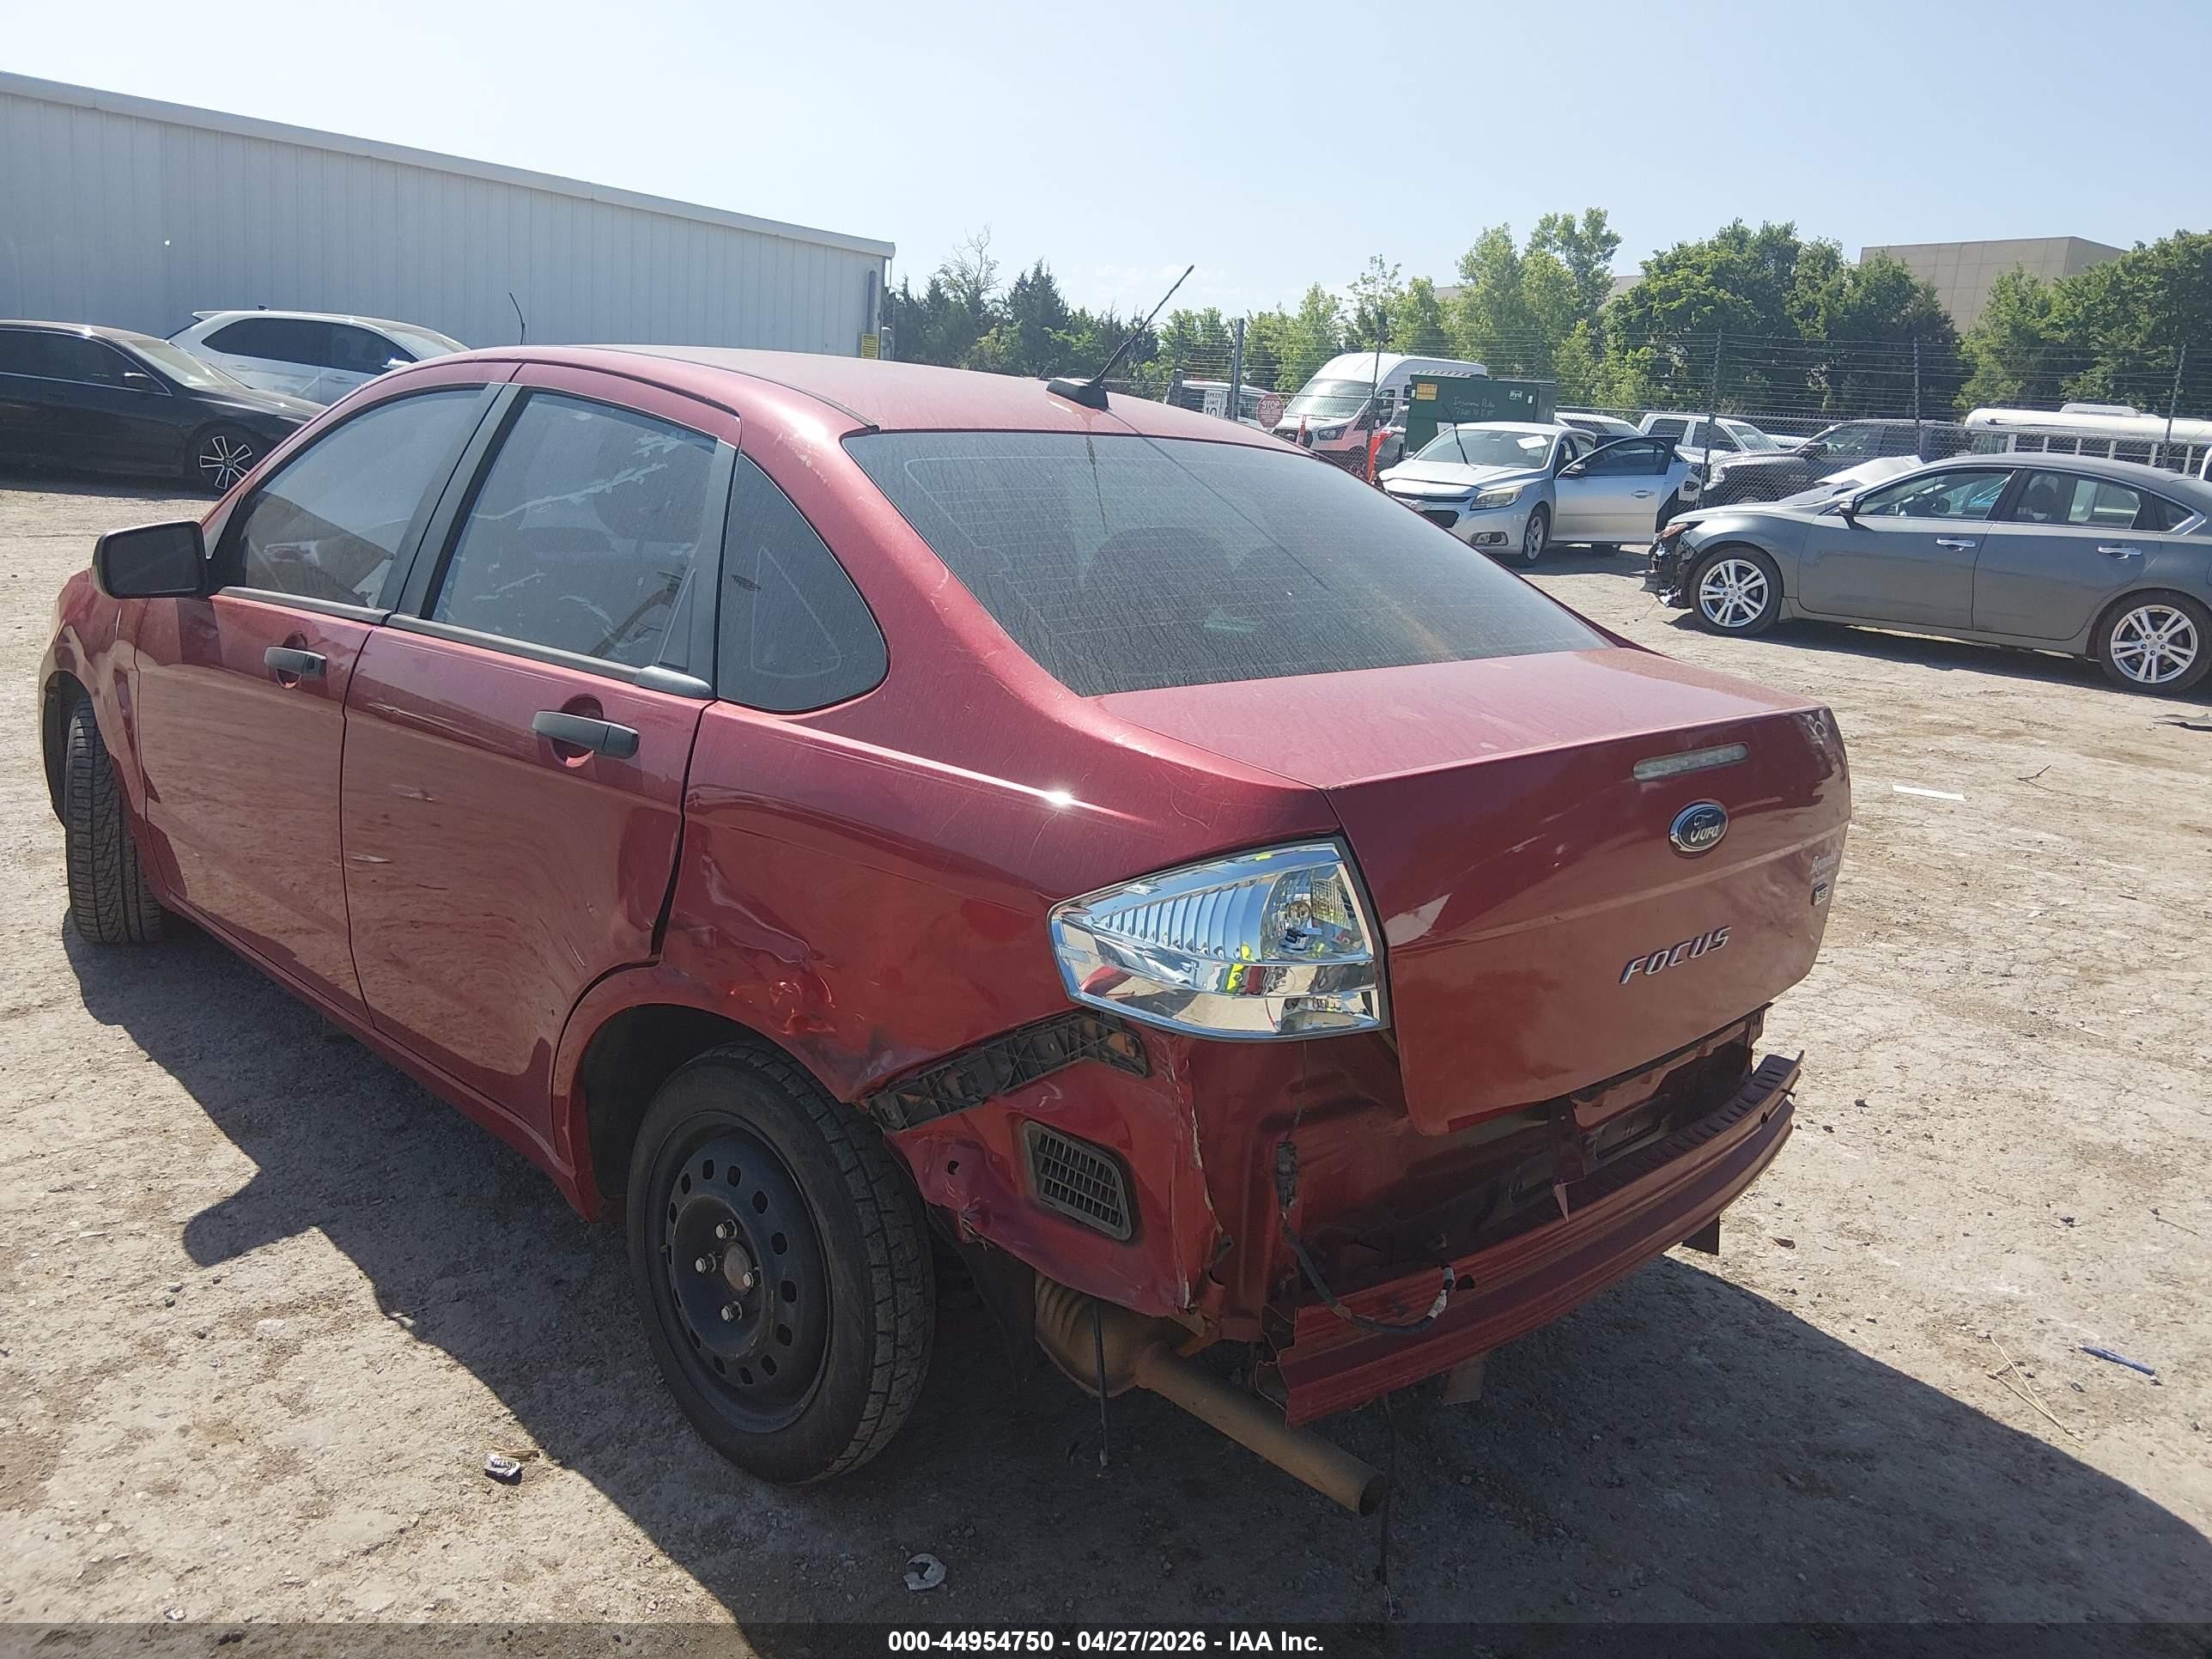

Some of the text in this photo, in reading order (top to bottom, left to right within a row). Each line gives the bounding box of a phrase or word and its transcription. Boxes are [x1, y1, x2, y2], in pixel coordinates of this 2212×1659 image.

[1261, 400, 1280, 410] STOP
[1690, 813, 1720, 842] Ford
[1620, 926, 1732, 984] FOCUS
